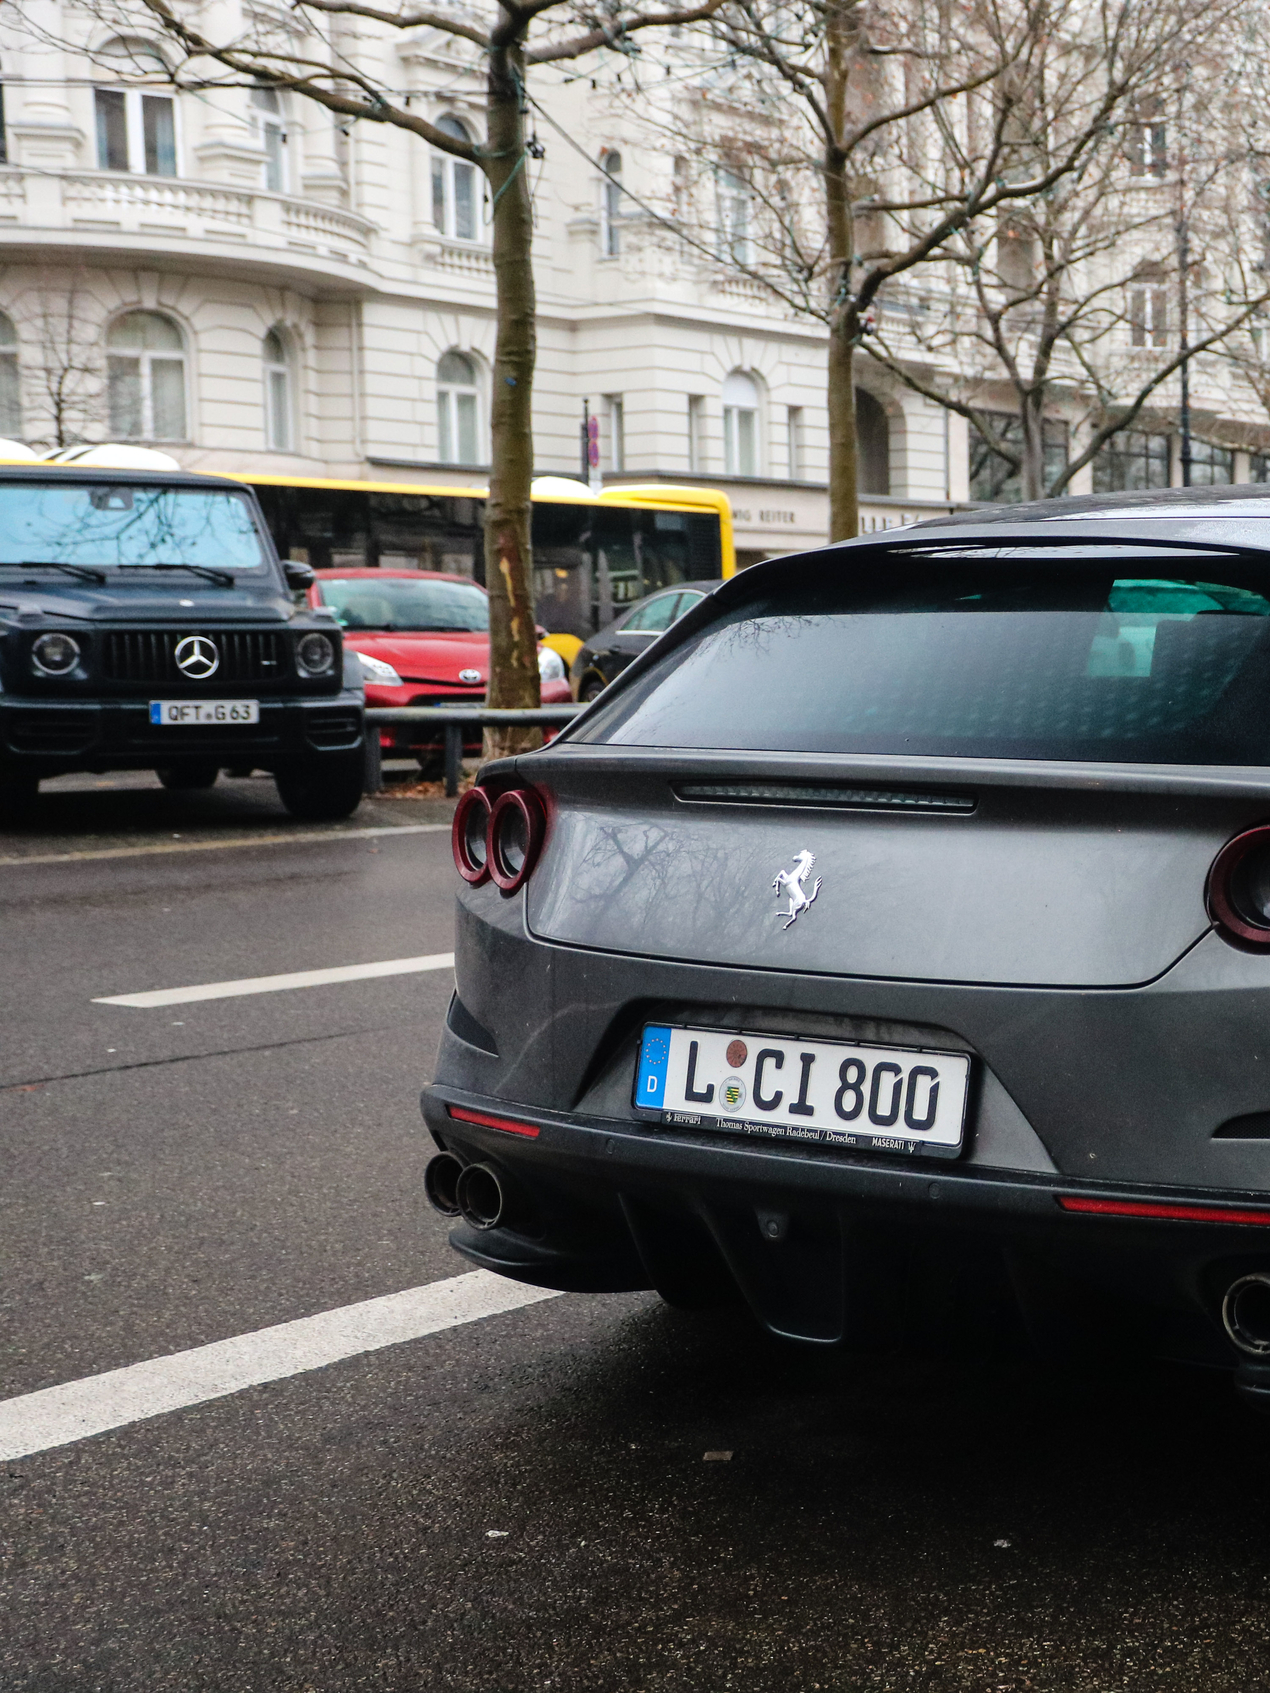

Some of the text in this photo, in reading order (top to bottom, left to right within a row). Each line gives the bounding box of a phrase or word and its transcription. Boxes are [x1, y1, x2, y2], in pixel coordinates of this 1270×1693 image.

[759, 509, 795, 523] REITER
[168, 705, 202, 721] QFT
[646, 1075, 658, 1092] D
[684, 1040, 940, 1131] L CI 800
[673, 1113, 701, 1125] Ferrari
[716, 1117, 743, 1130] Thomas
[744, 1121, 785, 1137] Sportwagen
[786, 1126, 820, 1140] Radebeul
[827, 1131, 857, 1144] Dresden
[872, 1137, 905, 1150] MASERATI
